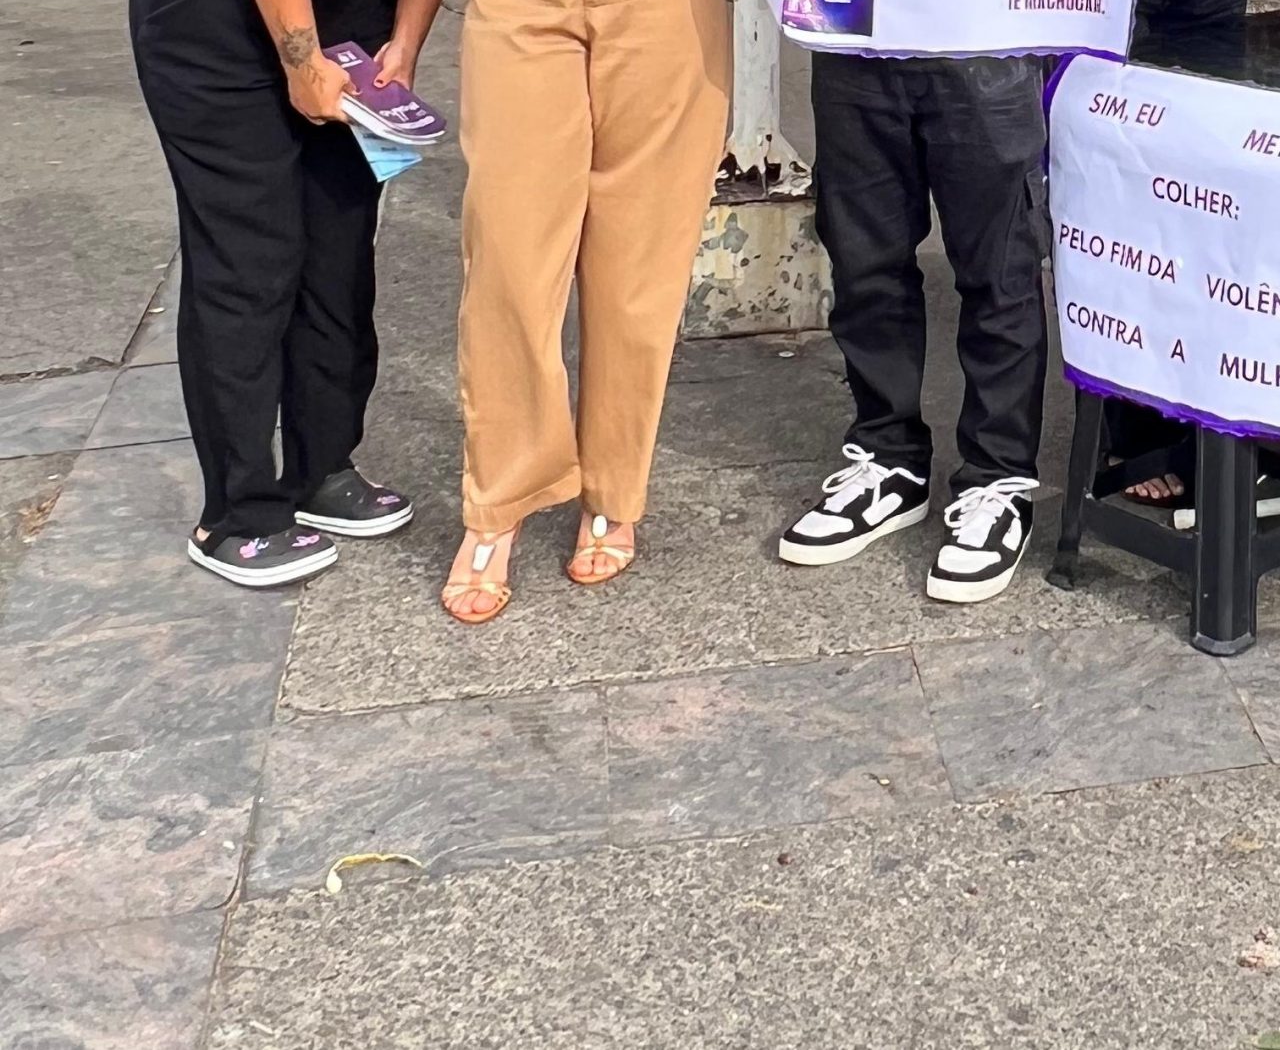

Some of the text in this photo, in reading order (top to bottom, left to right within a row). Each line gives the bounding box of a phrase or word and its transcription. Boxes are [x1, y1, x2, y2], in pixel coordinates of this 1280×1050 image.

[1088, 93, 1129, 124] SIM,
[1135, 103, 1166, 127] EU
[1152, 177, 1240, 220] COLHER:
[1059, 223, 1105, 257] PELO
[1110, 241, 1143, 273] FIM
[1147, 253, 1175, 284] DA
[1066, 301, 1143, 350] CONTRA
[1170, 339, 1186, 364] A
